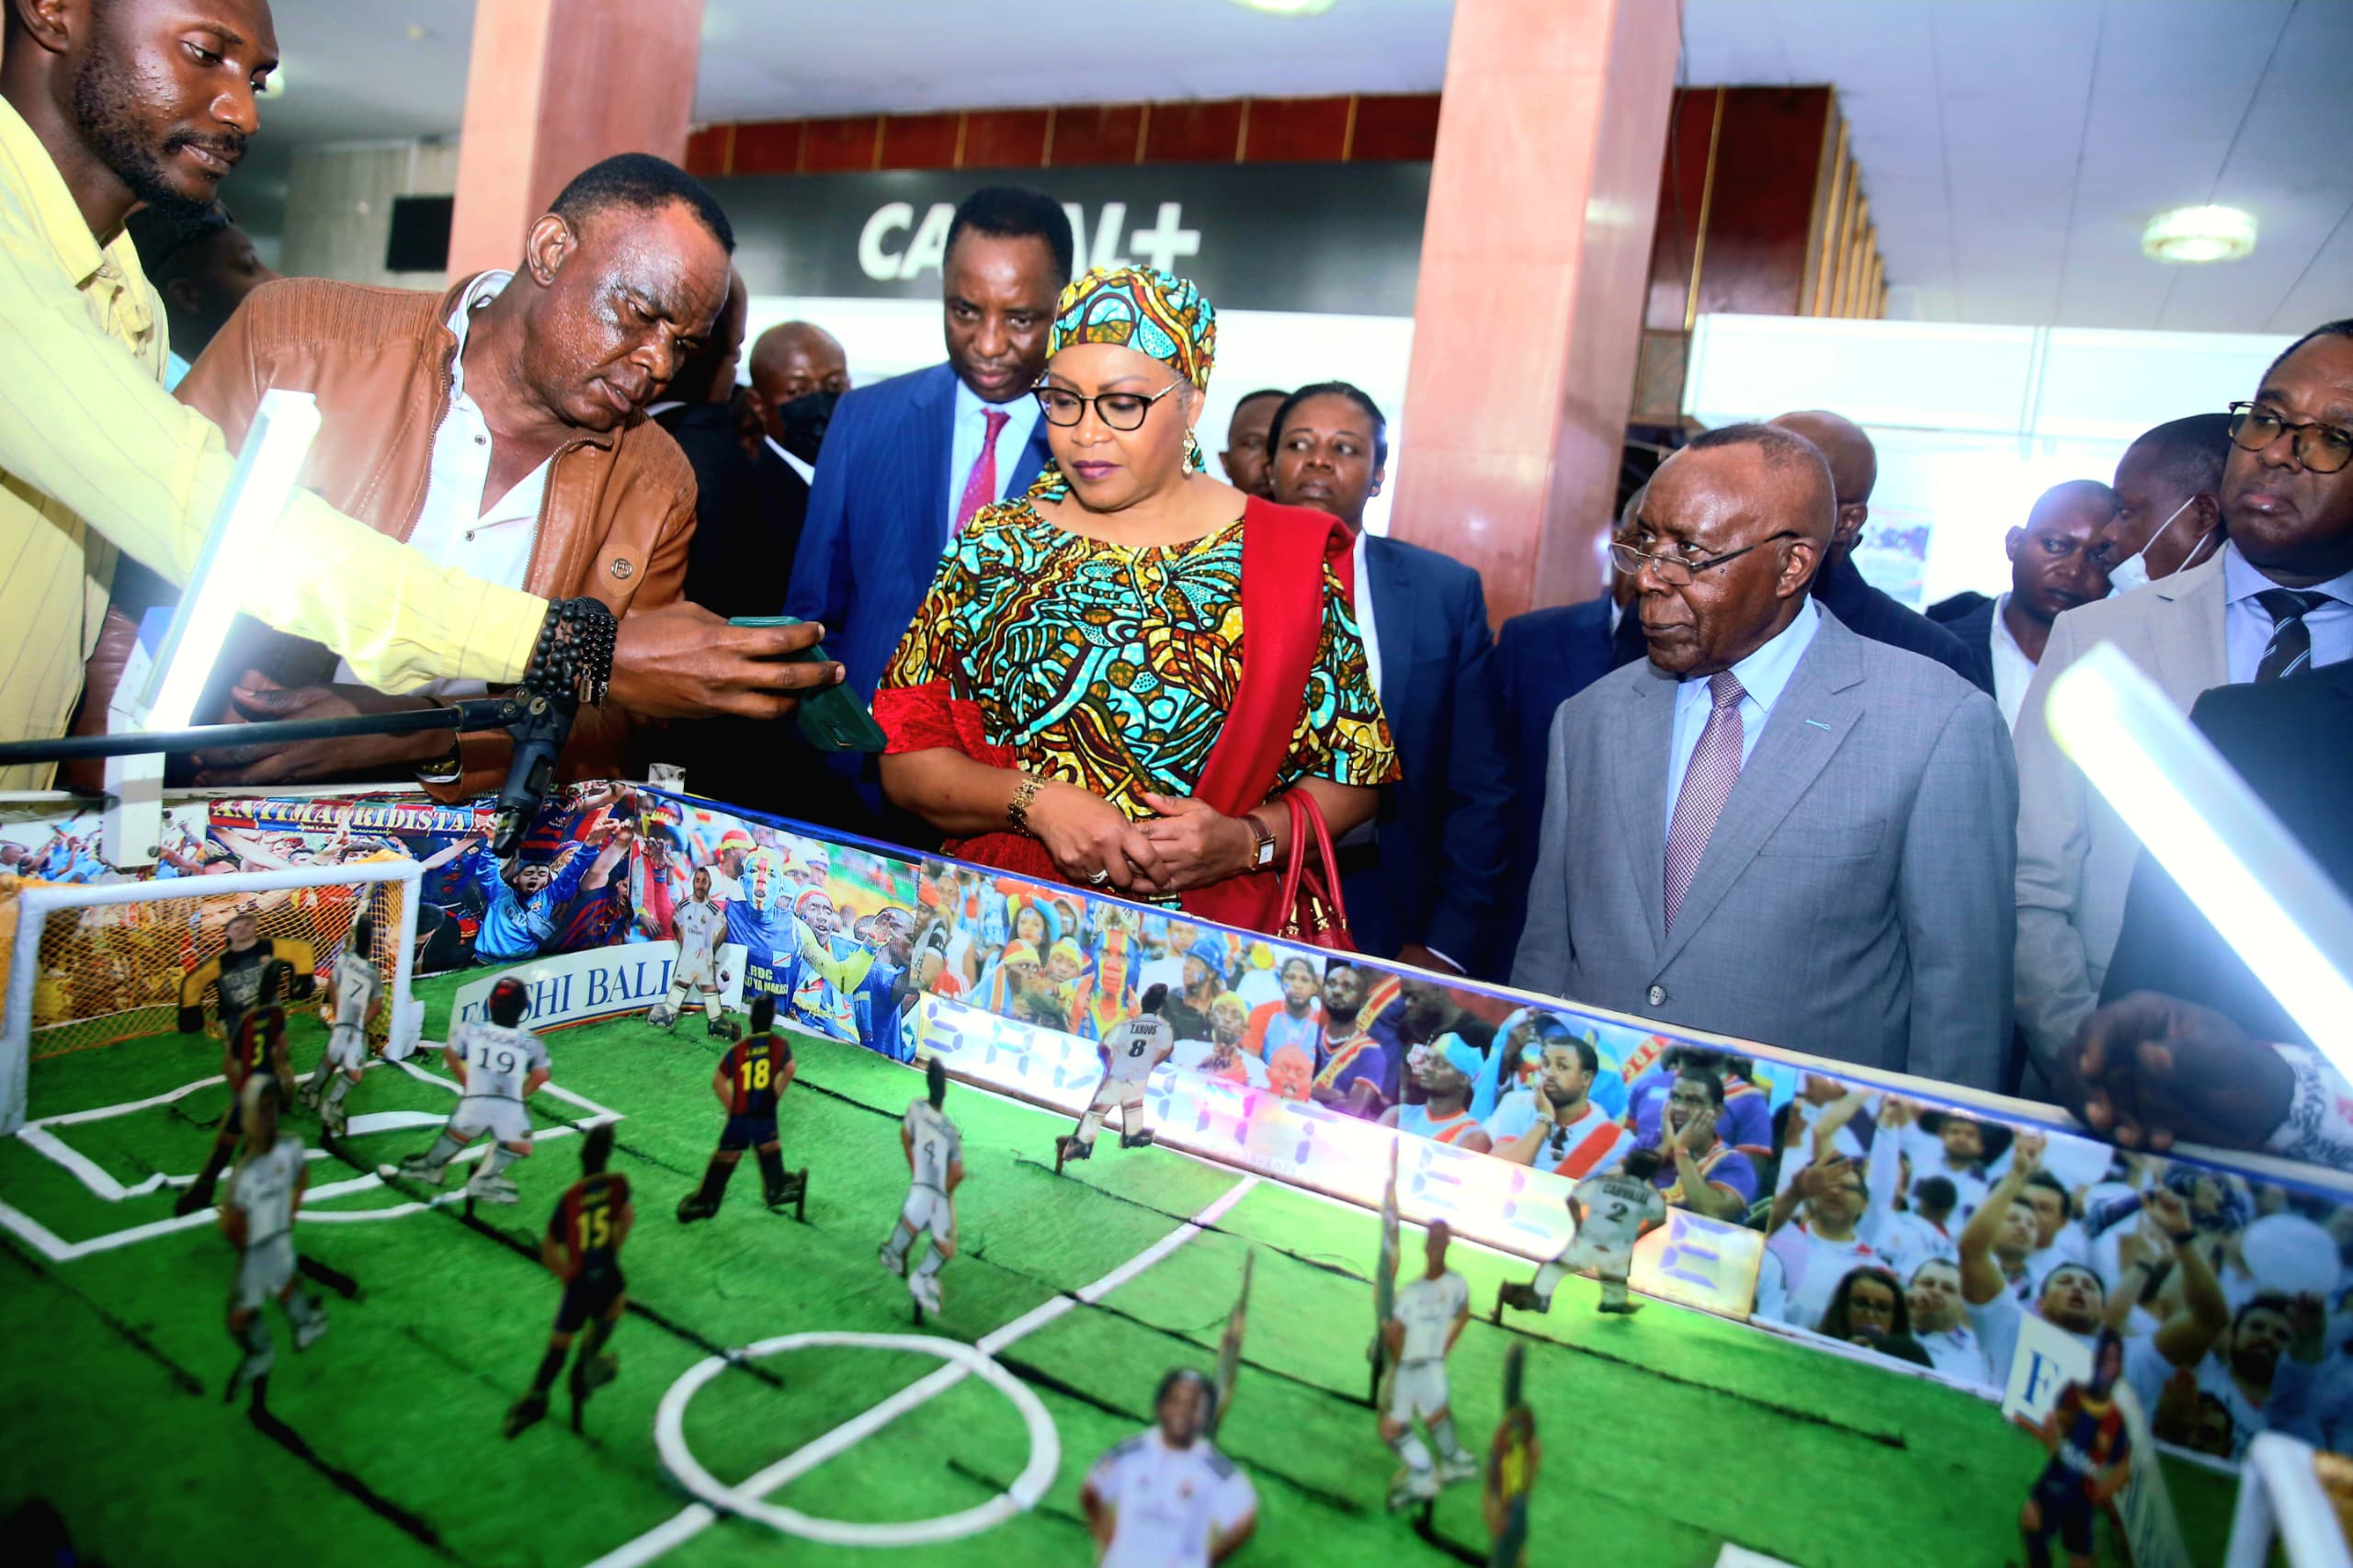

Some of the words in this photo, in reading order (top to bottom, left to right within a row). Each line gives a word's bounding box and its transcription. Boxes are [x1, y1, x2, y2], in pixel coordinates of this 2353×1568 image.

[858, 201, 1200, 280] CAL+
[750, 965, 773, 981] RDC
[349, 978, 363, 998] 7
[478, 1047, 516, 1074] 19
[1129, 1039, 1147, 1057] 8
[740, 1058, 770, 1090] 18
[1604, 1200, 1629, 1223] 2
[576, 1206, 610, 1251] 15
